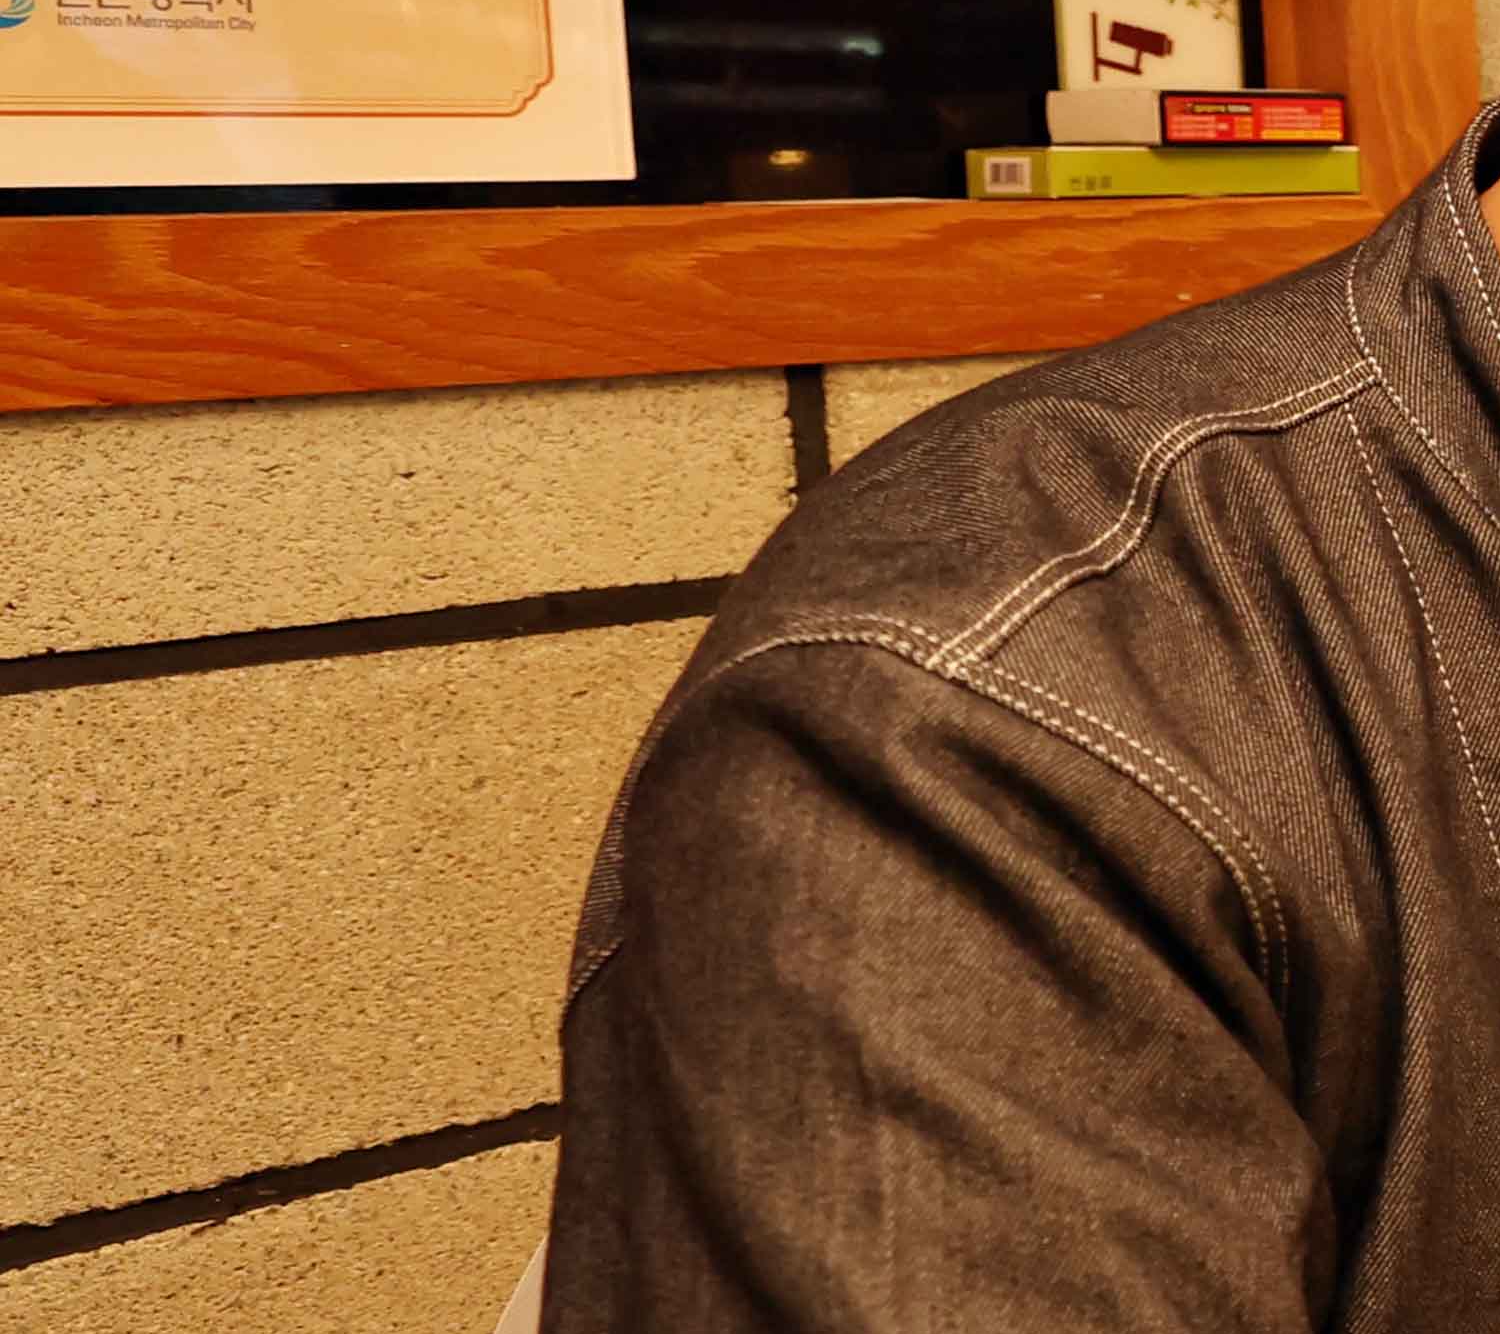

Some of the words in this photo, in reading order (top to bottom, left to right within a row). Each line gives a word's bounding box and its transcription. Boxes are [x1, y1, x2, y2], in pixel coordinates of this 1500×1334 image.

[57, 13, 123, 28] Incheon
[127, 14, 225, 31] Metropolitan
[228, 16, 257, 32] City
